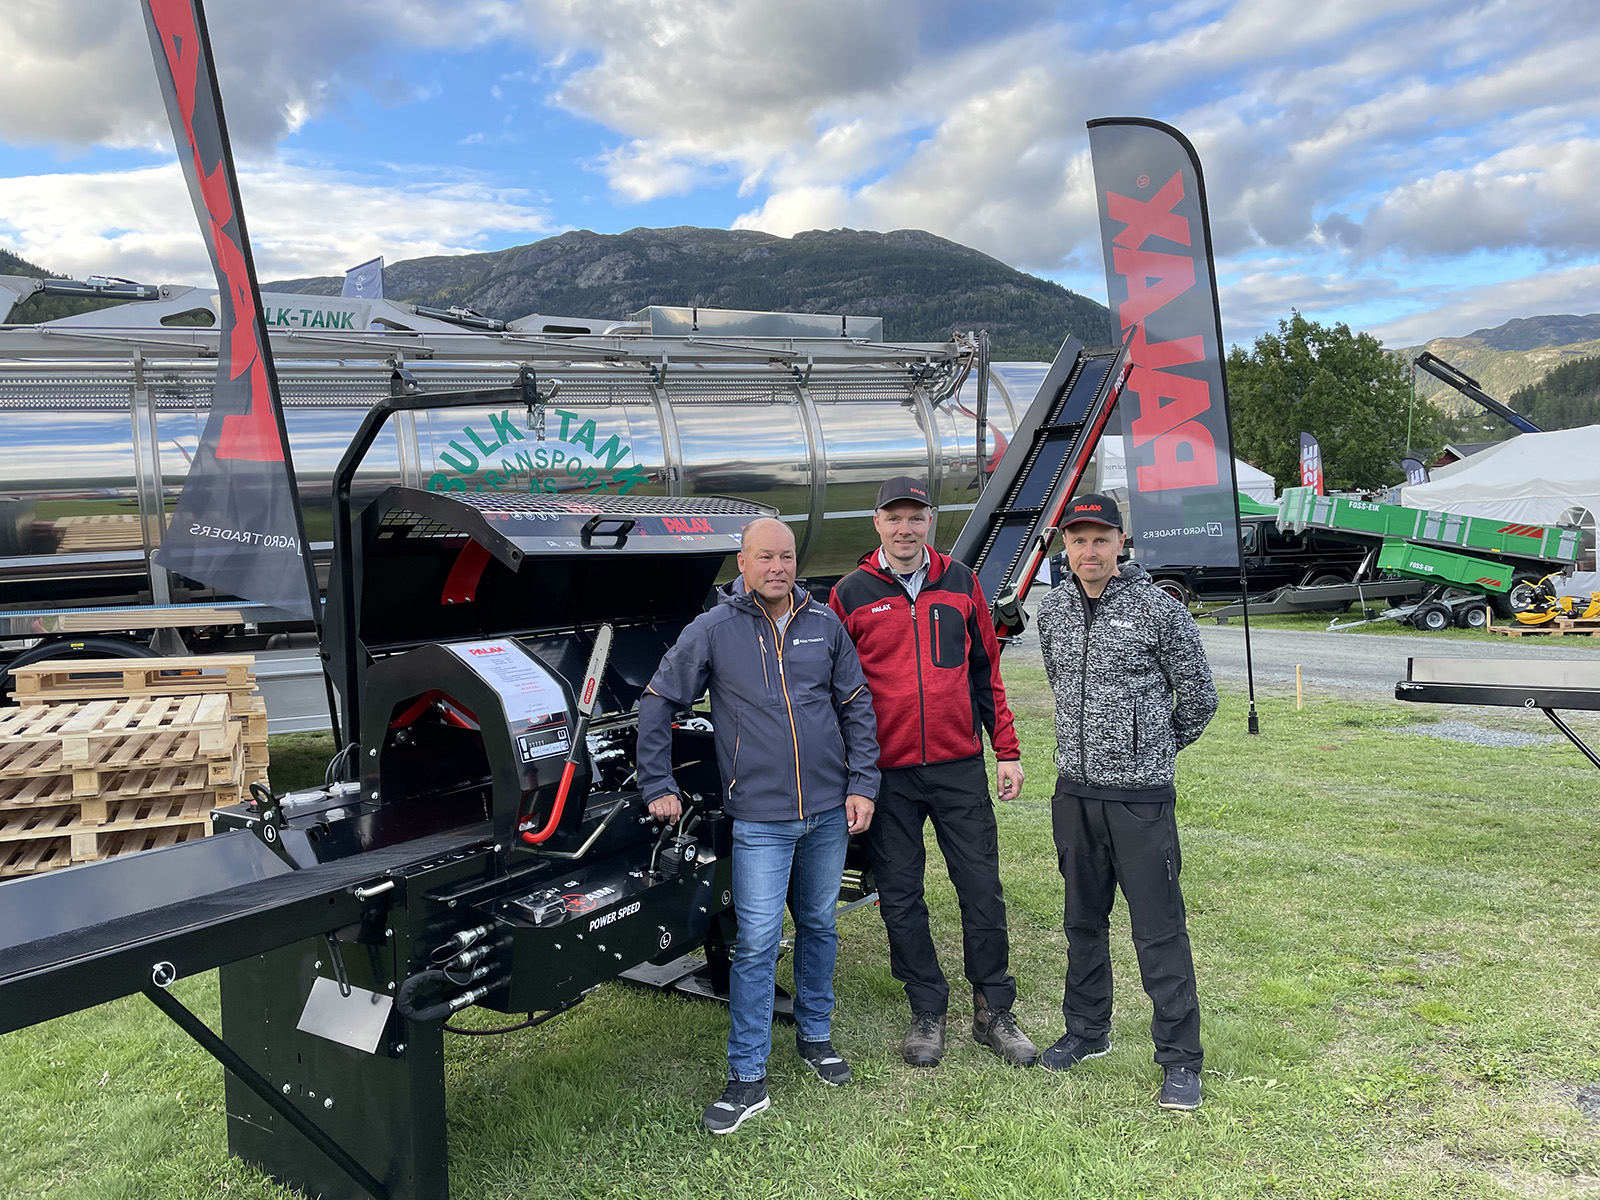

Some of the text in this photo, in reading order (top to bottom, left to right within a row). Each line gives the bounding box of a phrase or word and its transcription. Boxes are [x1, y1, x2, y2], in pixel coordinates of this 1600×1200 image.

[263, 307, 355, 330] LK-TANK
[427, 408, 650, 496] BULK TANK
[530, 477, 558, 494] AS
[1074, 504, 1102, 513] PALAX
[1348, 500, 1380, 512] FOSS-EIK
[661, 517, 715, 533] PALAX
[1409, 561, 1434, 572] FOSS-EIK
[871, 603, 892, 614] PALAX
[1110, 619, 1134, 629] PALAX
[468, 646, 507, 656] PALAX
[584, 679, 595, 703] OREGON
[589, 901, 641, 932] POWER SPEED
